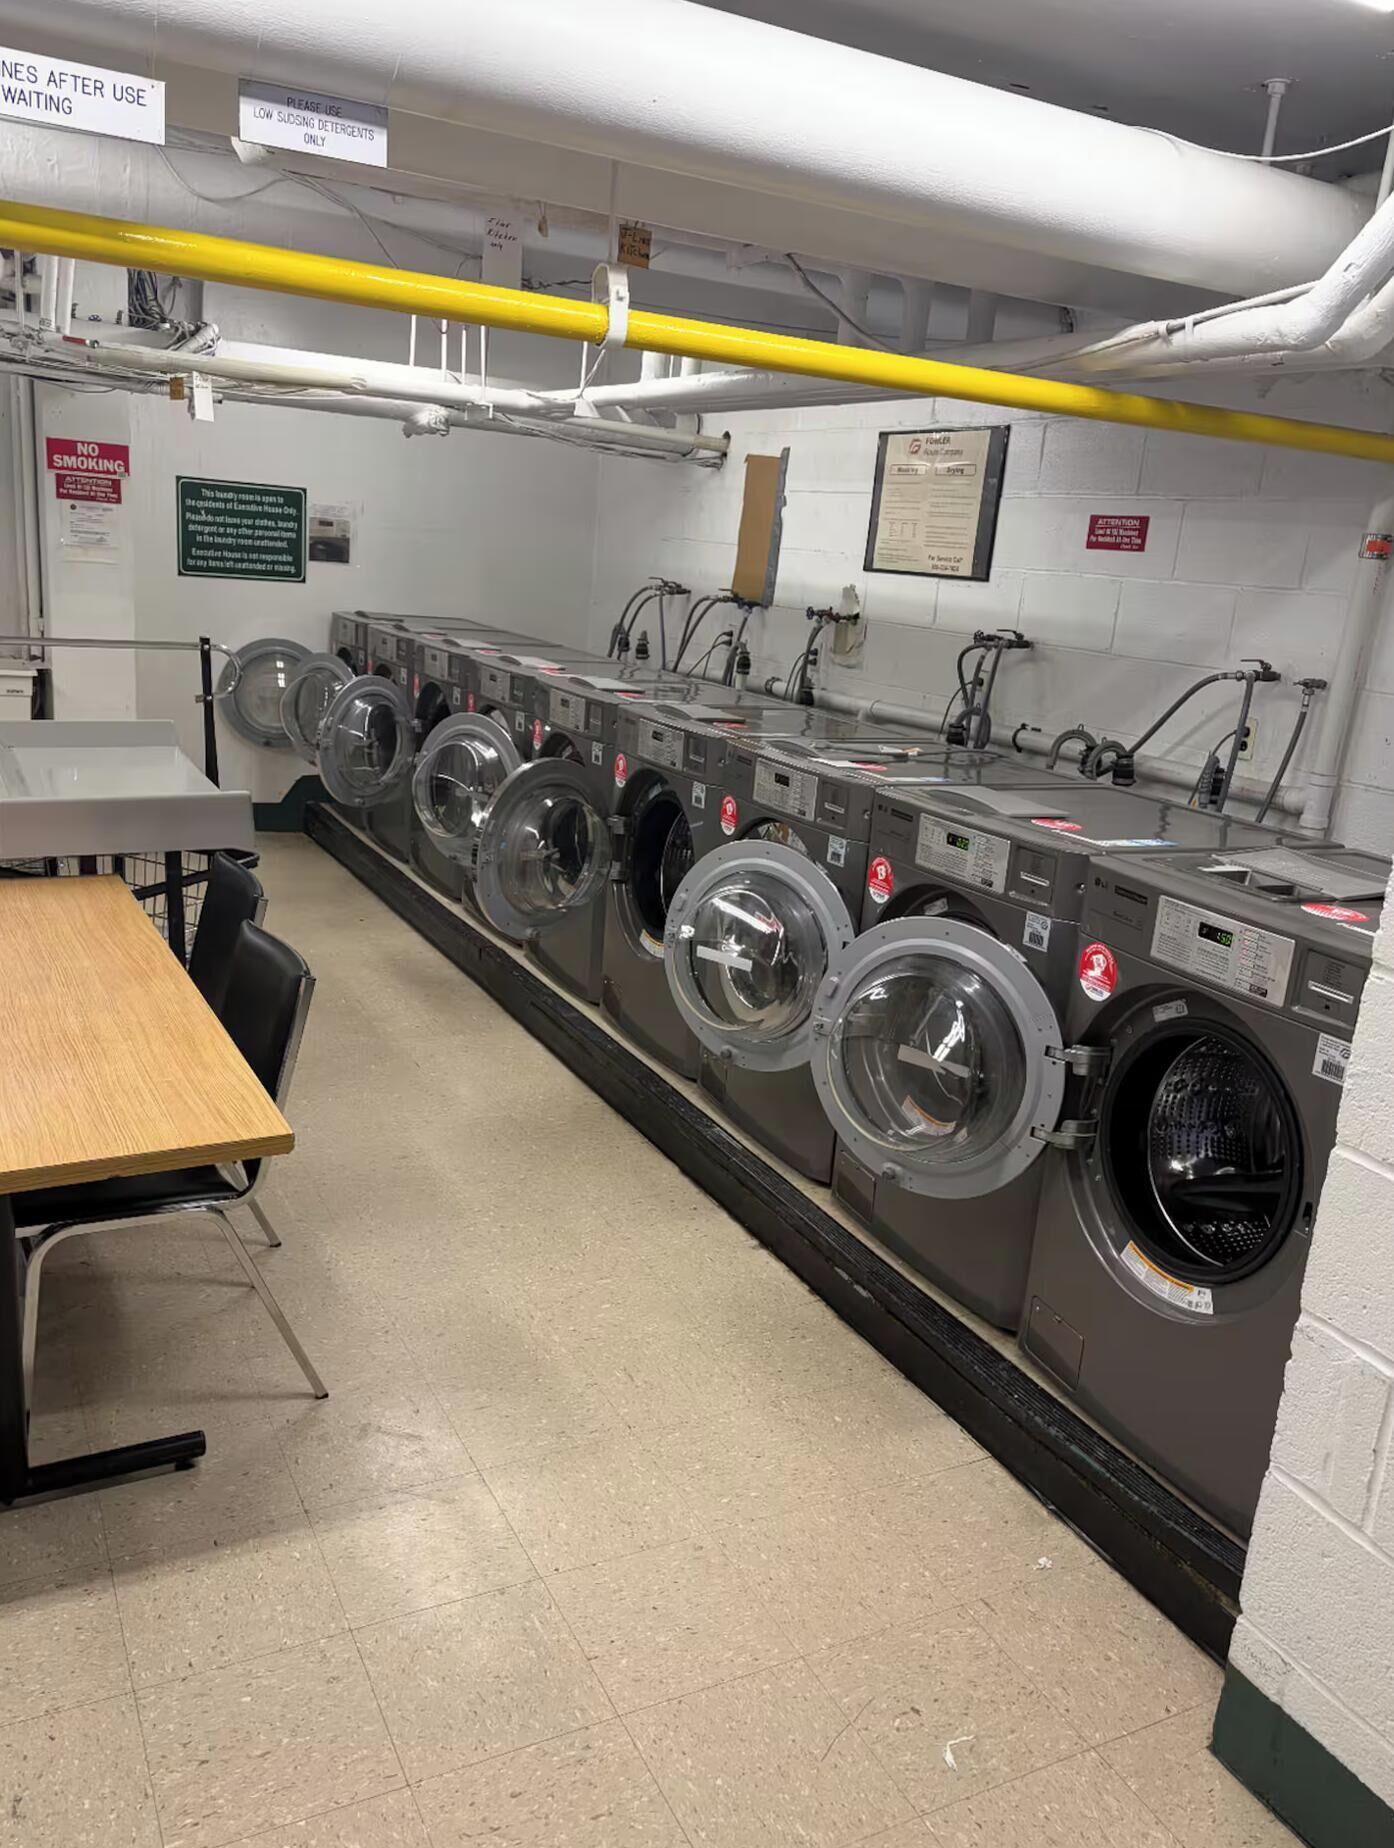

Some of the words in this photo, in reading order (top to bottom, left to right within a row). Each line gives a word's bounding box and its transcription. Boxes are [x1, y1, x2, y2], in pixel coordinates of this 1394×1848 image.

[47, 69, 104, 98] AFTER
[112, 83, 147, 107] USE
[1, 84, 72, 115] WAITING
[286, 96, 321, 114] PLEASE
[325, 104, 342, 118] USE
[253, 106, 274, 120] LOW
[277, 111, 314, 130] SUDSING
[318, 118, 375, 142] DETERGENTS
[304, 132, 326, 148] ONLY
[76, 442, 99, 456] NO
[52, 454, 124, 472] SMOKING
[1097, 518, 1140, 526] ATTENTION
